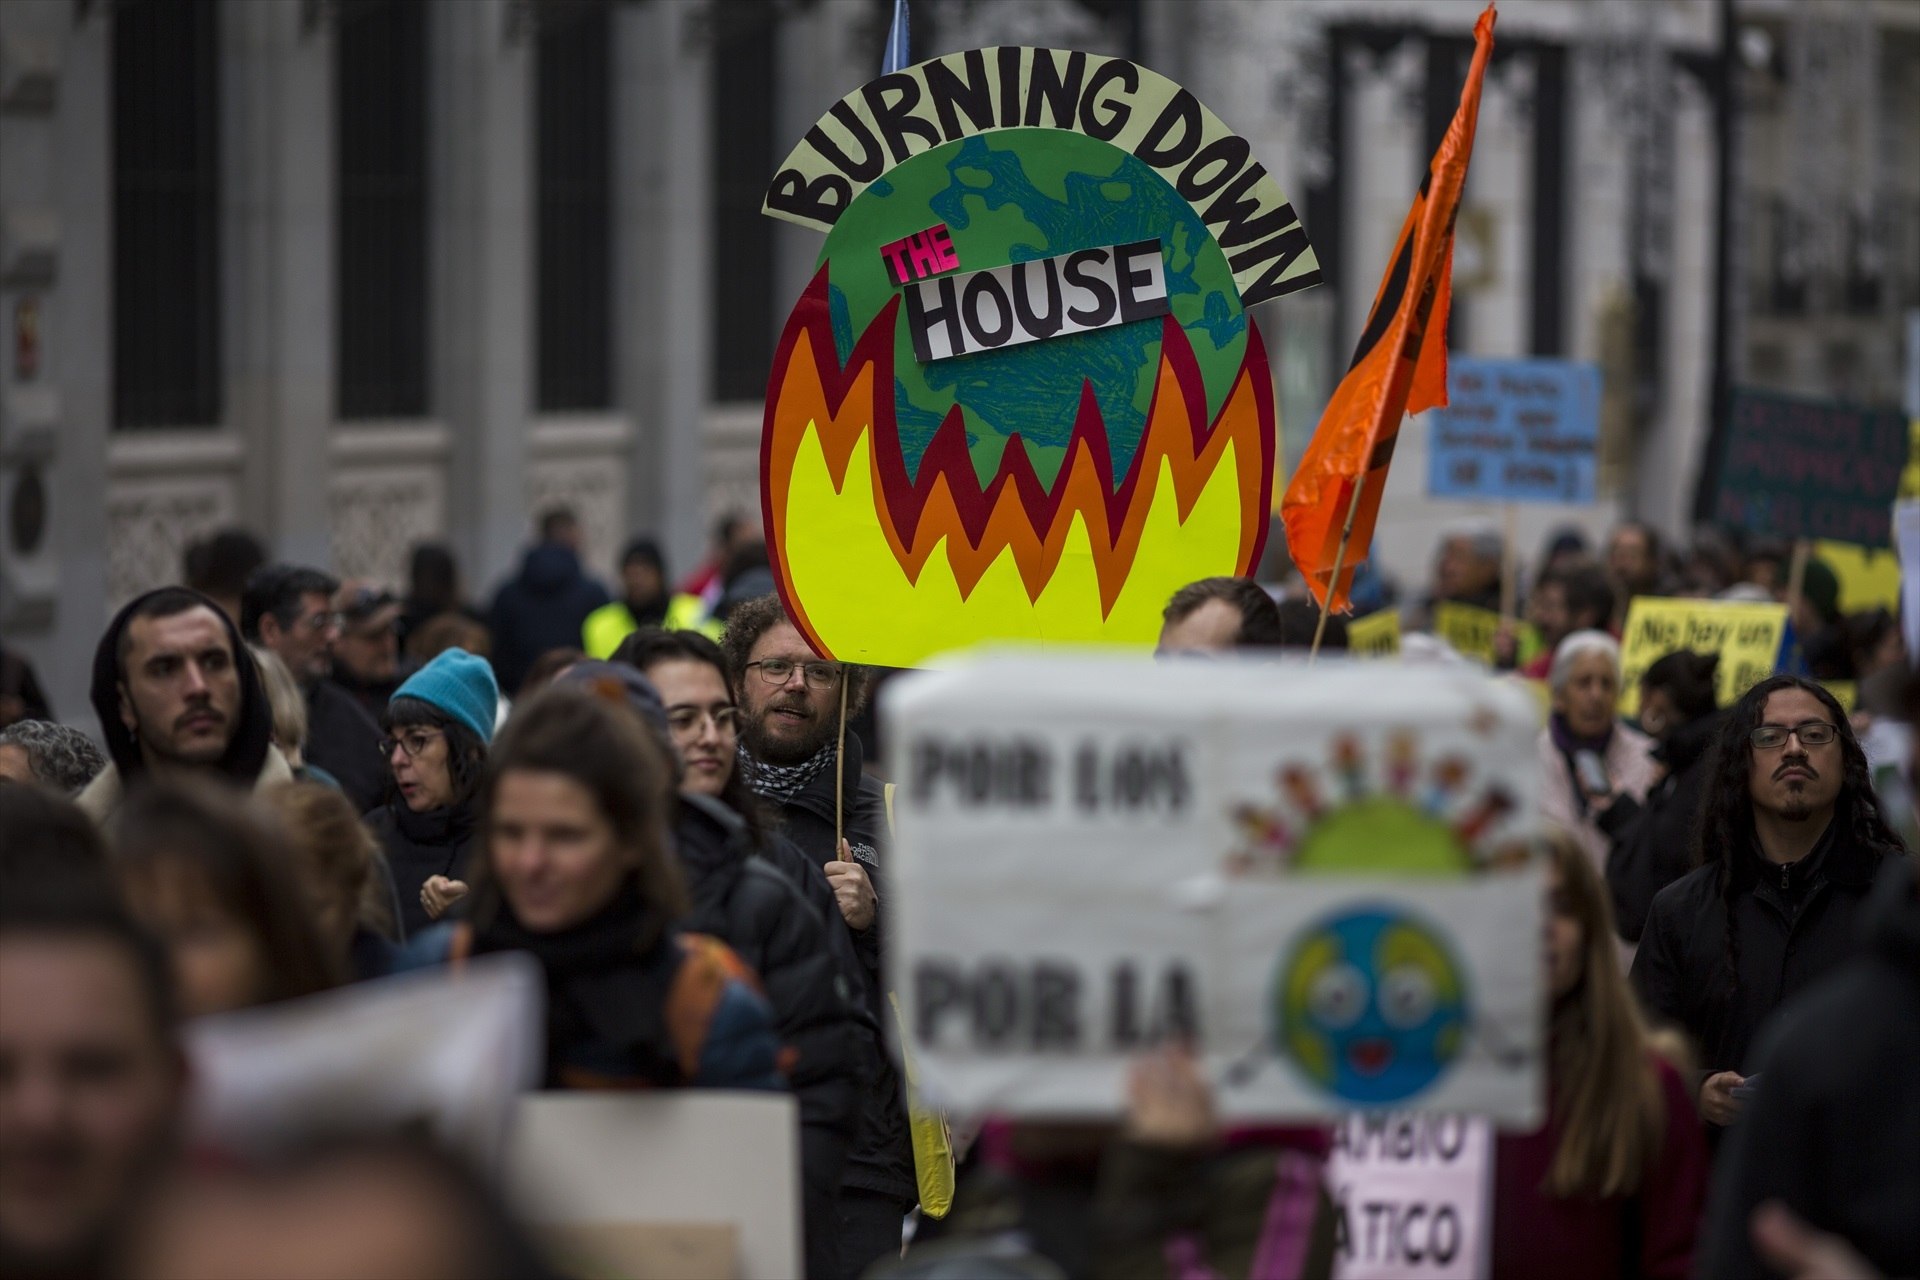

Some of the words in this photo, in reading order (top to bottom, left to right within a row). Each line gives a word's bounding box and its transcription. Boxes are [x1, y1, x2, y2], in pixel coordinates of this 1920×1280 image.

[767, 46, 1139, 226] BURNING
[1135, 87, 1323, 308] DOWN
[881, 225, 958, 283] THE
[903, 239, 1168, 362] HOUSE
[909, 737, 1055, 809] POR
[911, 961, 1084, 1052] POR
[1110, 961, 1206, 1052] LA
